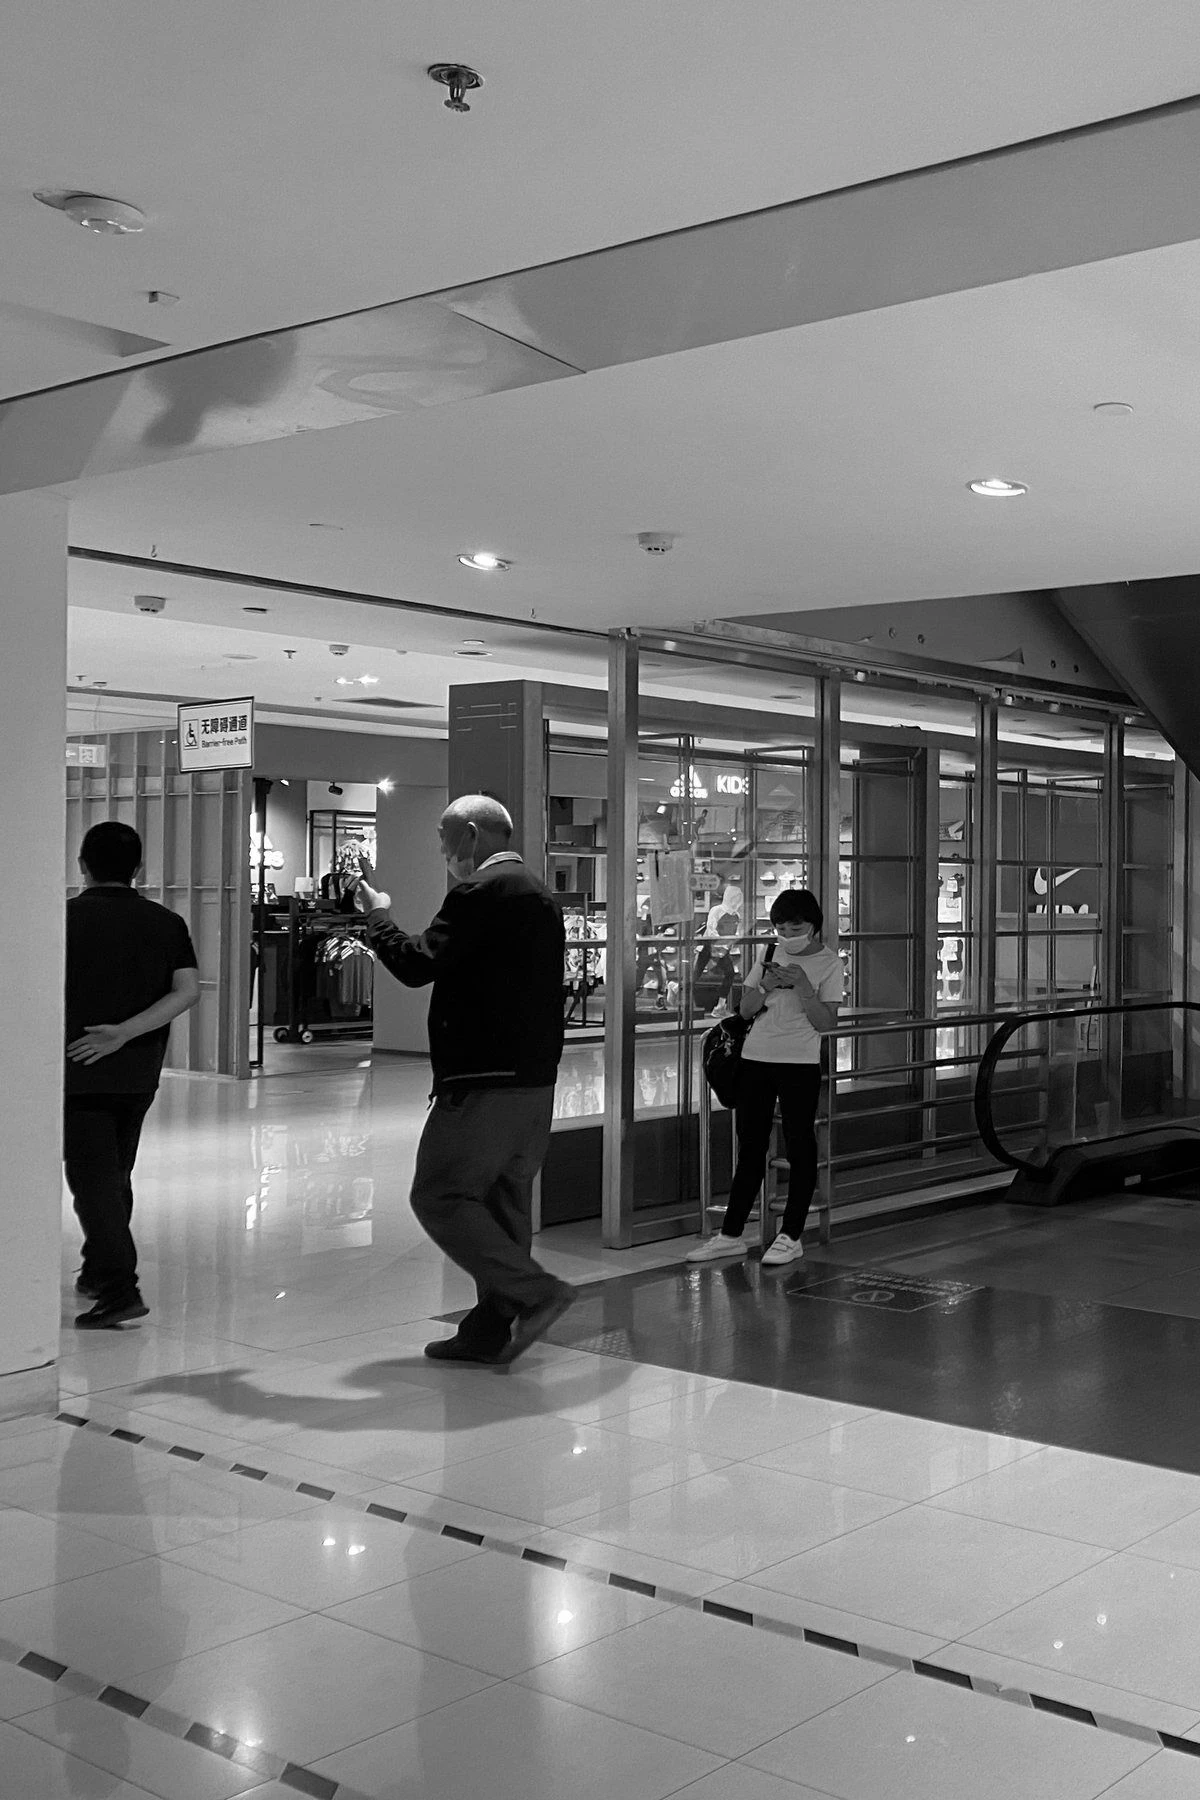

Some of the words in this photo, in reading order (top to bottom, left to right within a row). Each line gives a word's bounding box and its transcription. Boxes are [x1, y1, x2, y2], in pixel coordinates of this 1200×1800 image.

[201, 715, 247, 734] 无障碍通道
[201, 738, 233, 748] Barrier-free
[716, 774, 750, 795] KIDS
